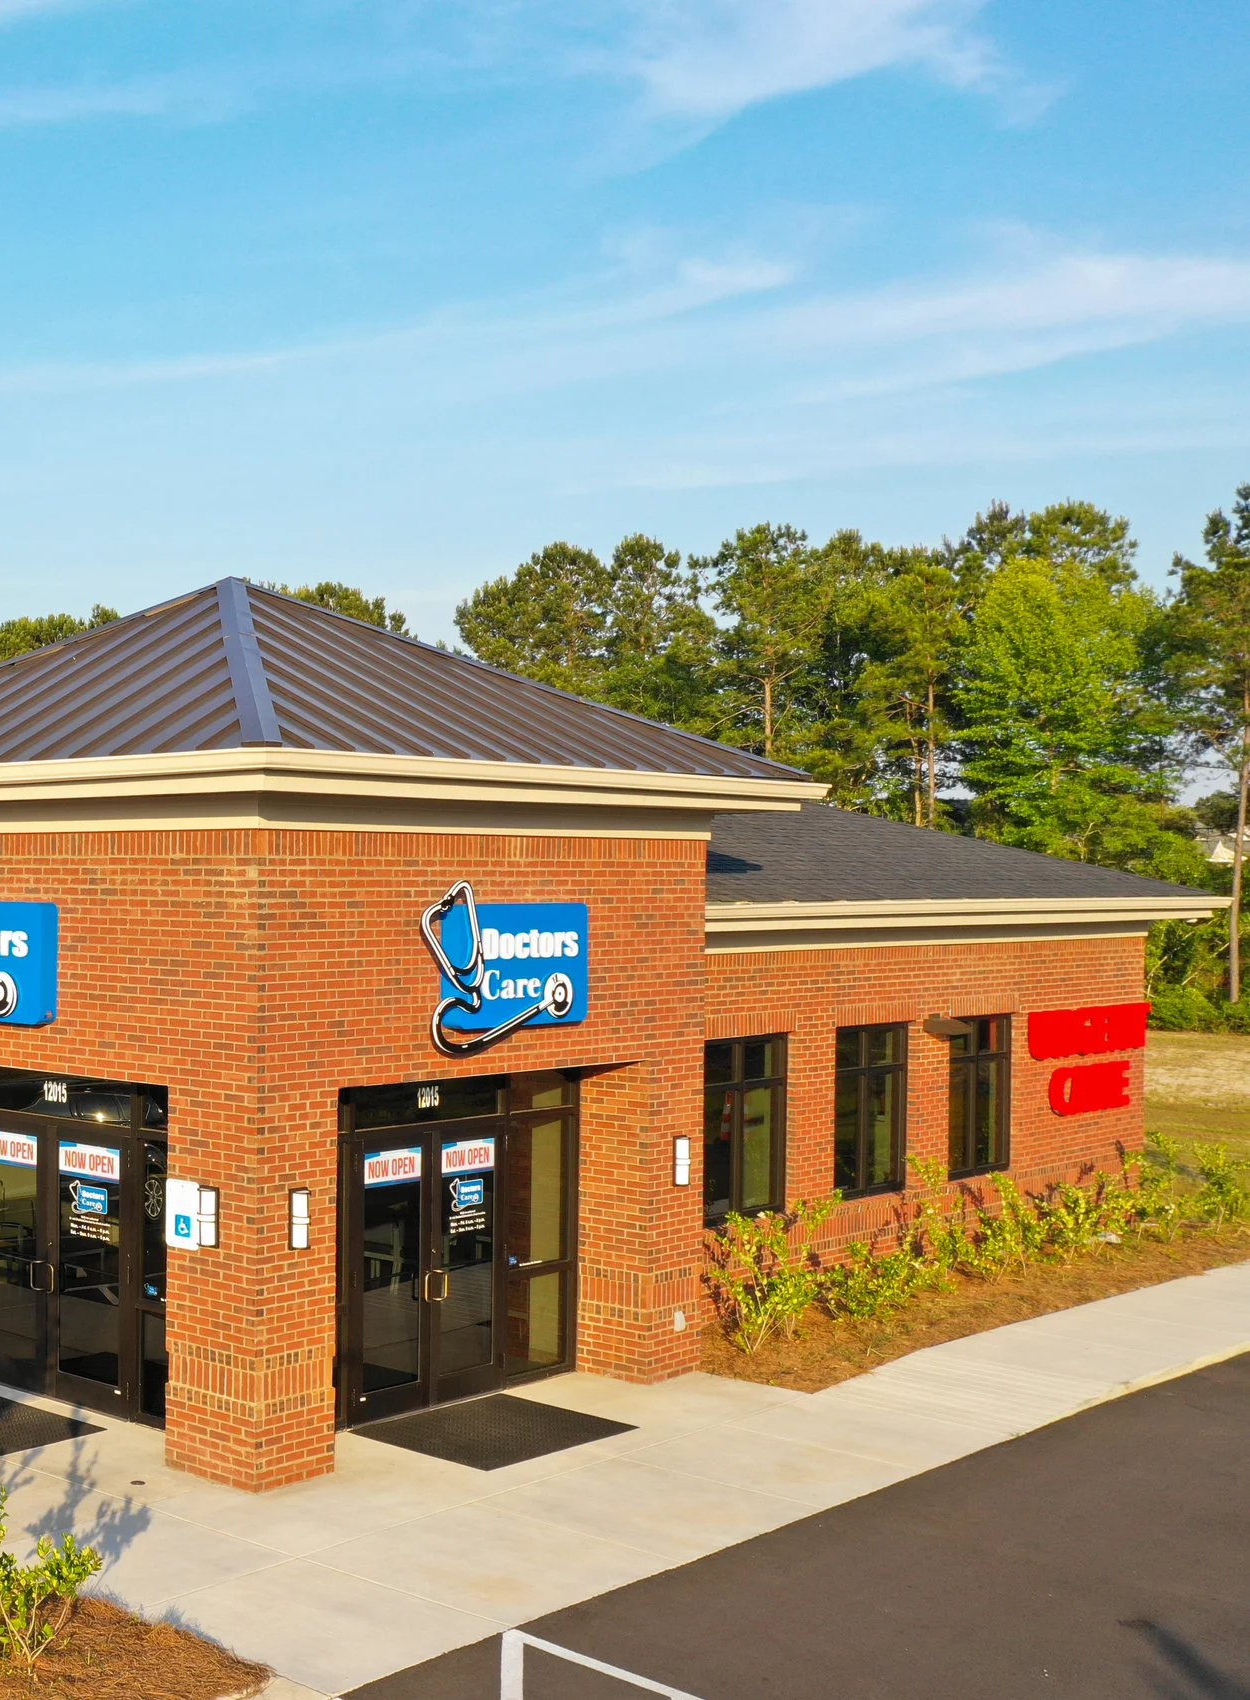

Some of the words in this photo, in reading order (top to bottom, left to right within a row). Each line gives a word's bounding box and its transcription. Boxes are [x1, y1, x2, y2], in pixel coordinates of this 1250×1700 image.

[482, 928, 579, 960] Doctors
[482, 970, 542, 1000] Care
[43, 1081, 67, 1103] 12015
[417, 1086, 439, 1109] 12015
[10, 1142, 34, 1160] OPEN
[65, 1150, 86, 1170] NOW
[89, 1154, 114, 1174] OPEN
[446, 1150, 465, 1168] NOW
[468, 1147, 490, 1165] OPEN
[368, 1160, 389, 1179] NOW
[391, 1156, 415, 1176] OPEN
